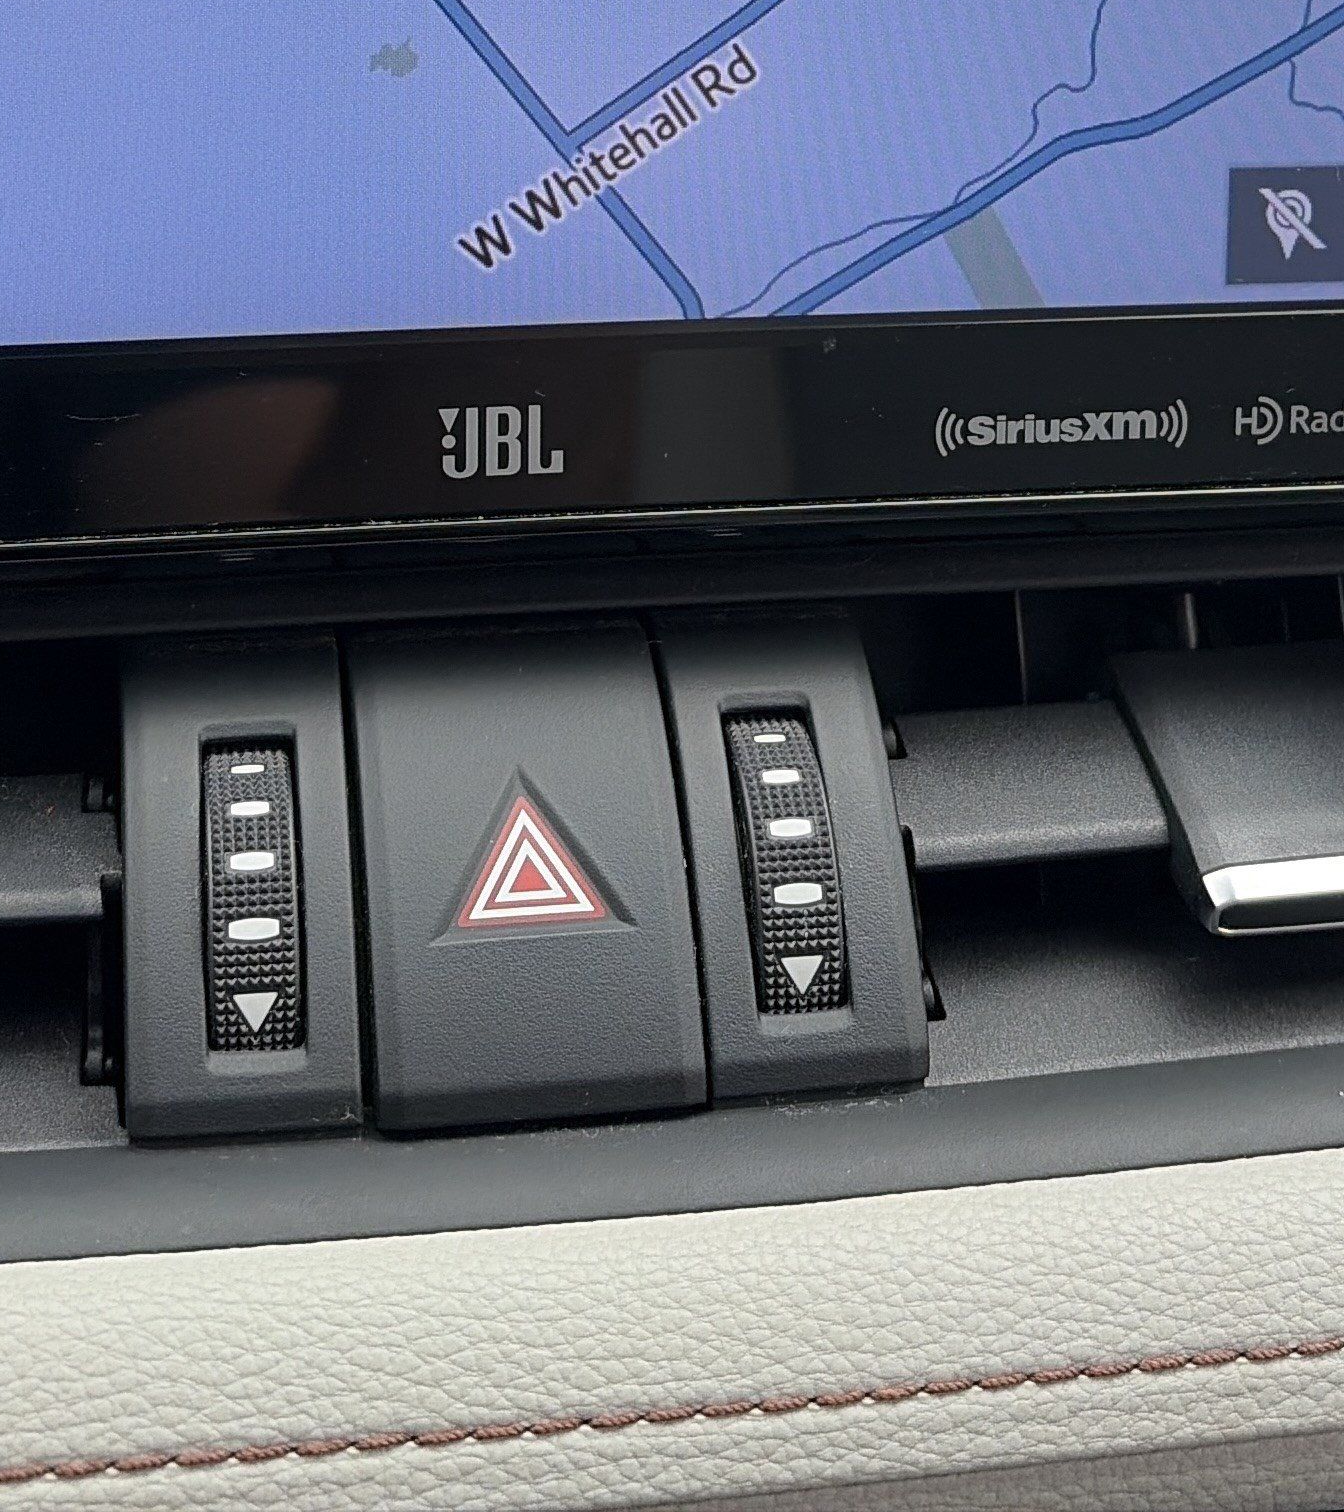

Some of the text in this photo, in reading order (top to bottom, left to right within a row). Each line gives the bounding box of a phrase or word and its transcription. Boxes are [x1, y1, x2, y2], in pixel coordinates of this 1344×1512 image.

[457, 43, 759, 270] W Whitehall Rd
[441, 404, 565, 479] JBL
